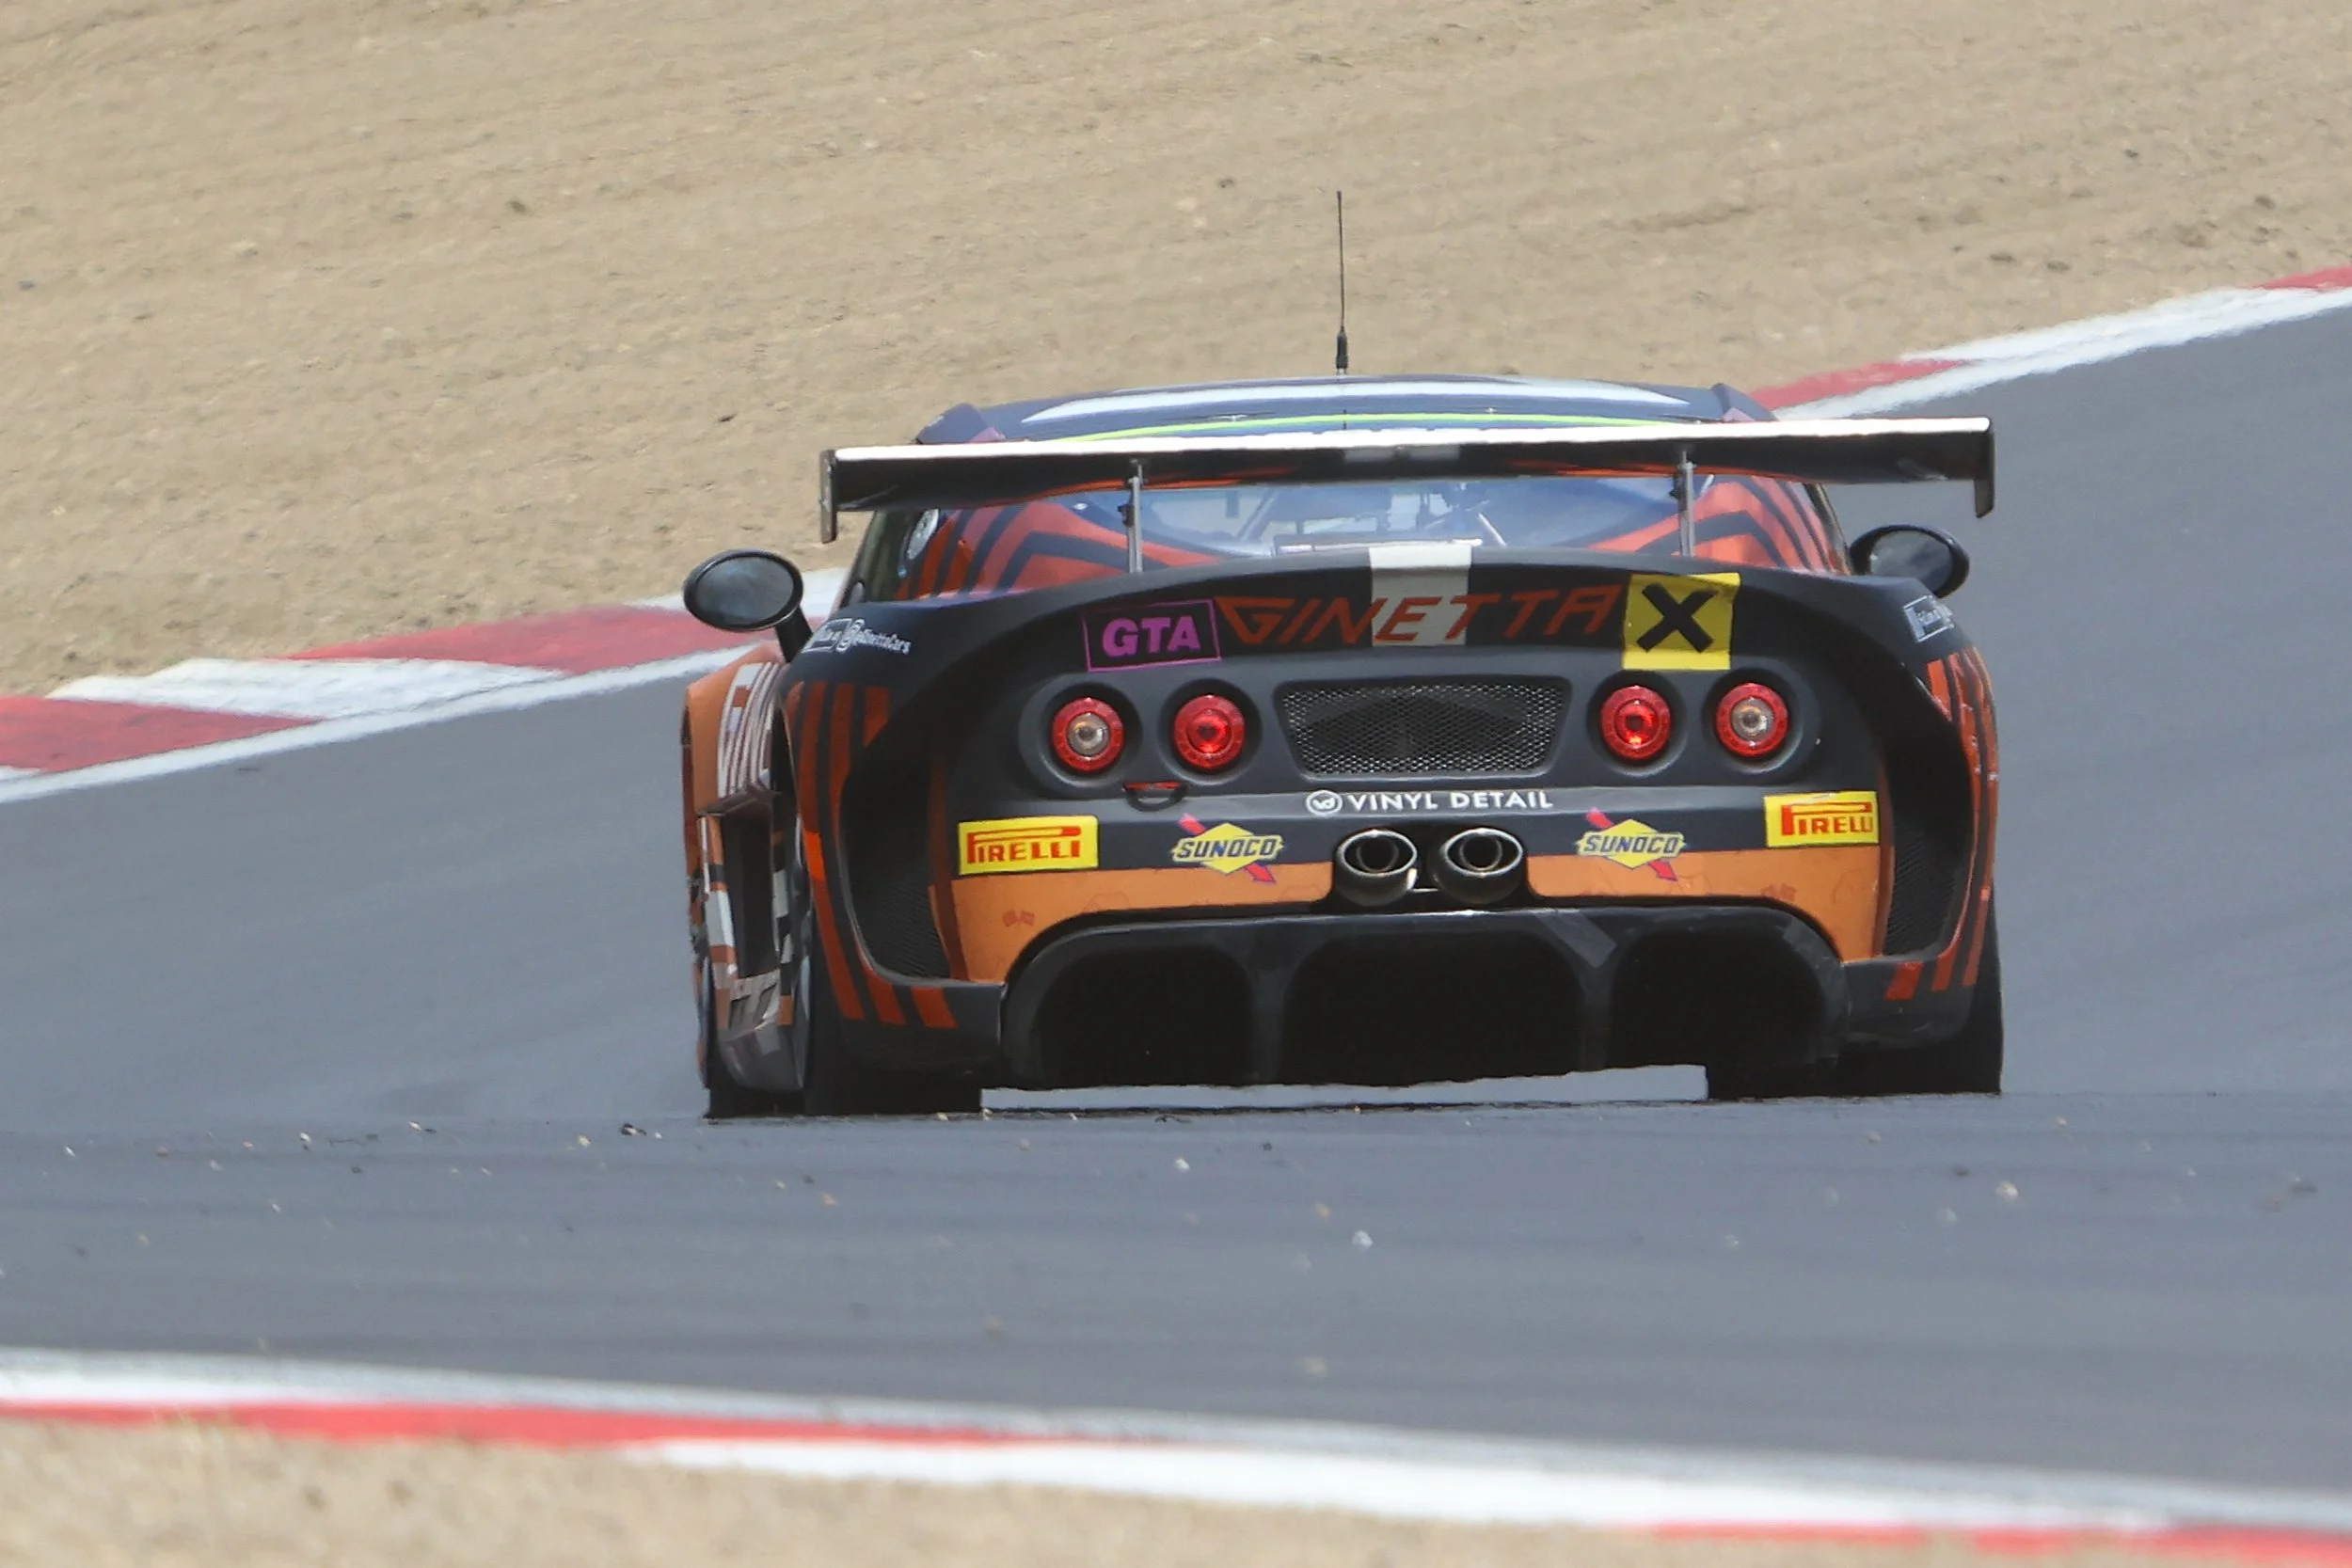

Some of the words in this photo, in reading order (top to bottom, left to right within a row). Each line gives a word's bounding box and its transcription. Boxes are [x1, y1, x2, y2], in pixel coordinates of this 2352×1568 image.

[1215, 584, 1623, 645] GINETTA
[1636, 582, 1717, 654] X
[1103, 615, 1200, 657] GTA
[1347, 792, 1438, 812] VINYL
[1451, 790, 1554, 810] DETAIL
[1780, 800, 1875, 837] PIRELLI
[966, 825, 1082, 864] PIRELLI
[1176, 837, 1278, 859] SUNOCO
[1581, 833, 1680, 855] SUNOCO
